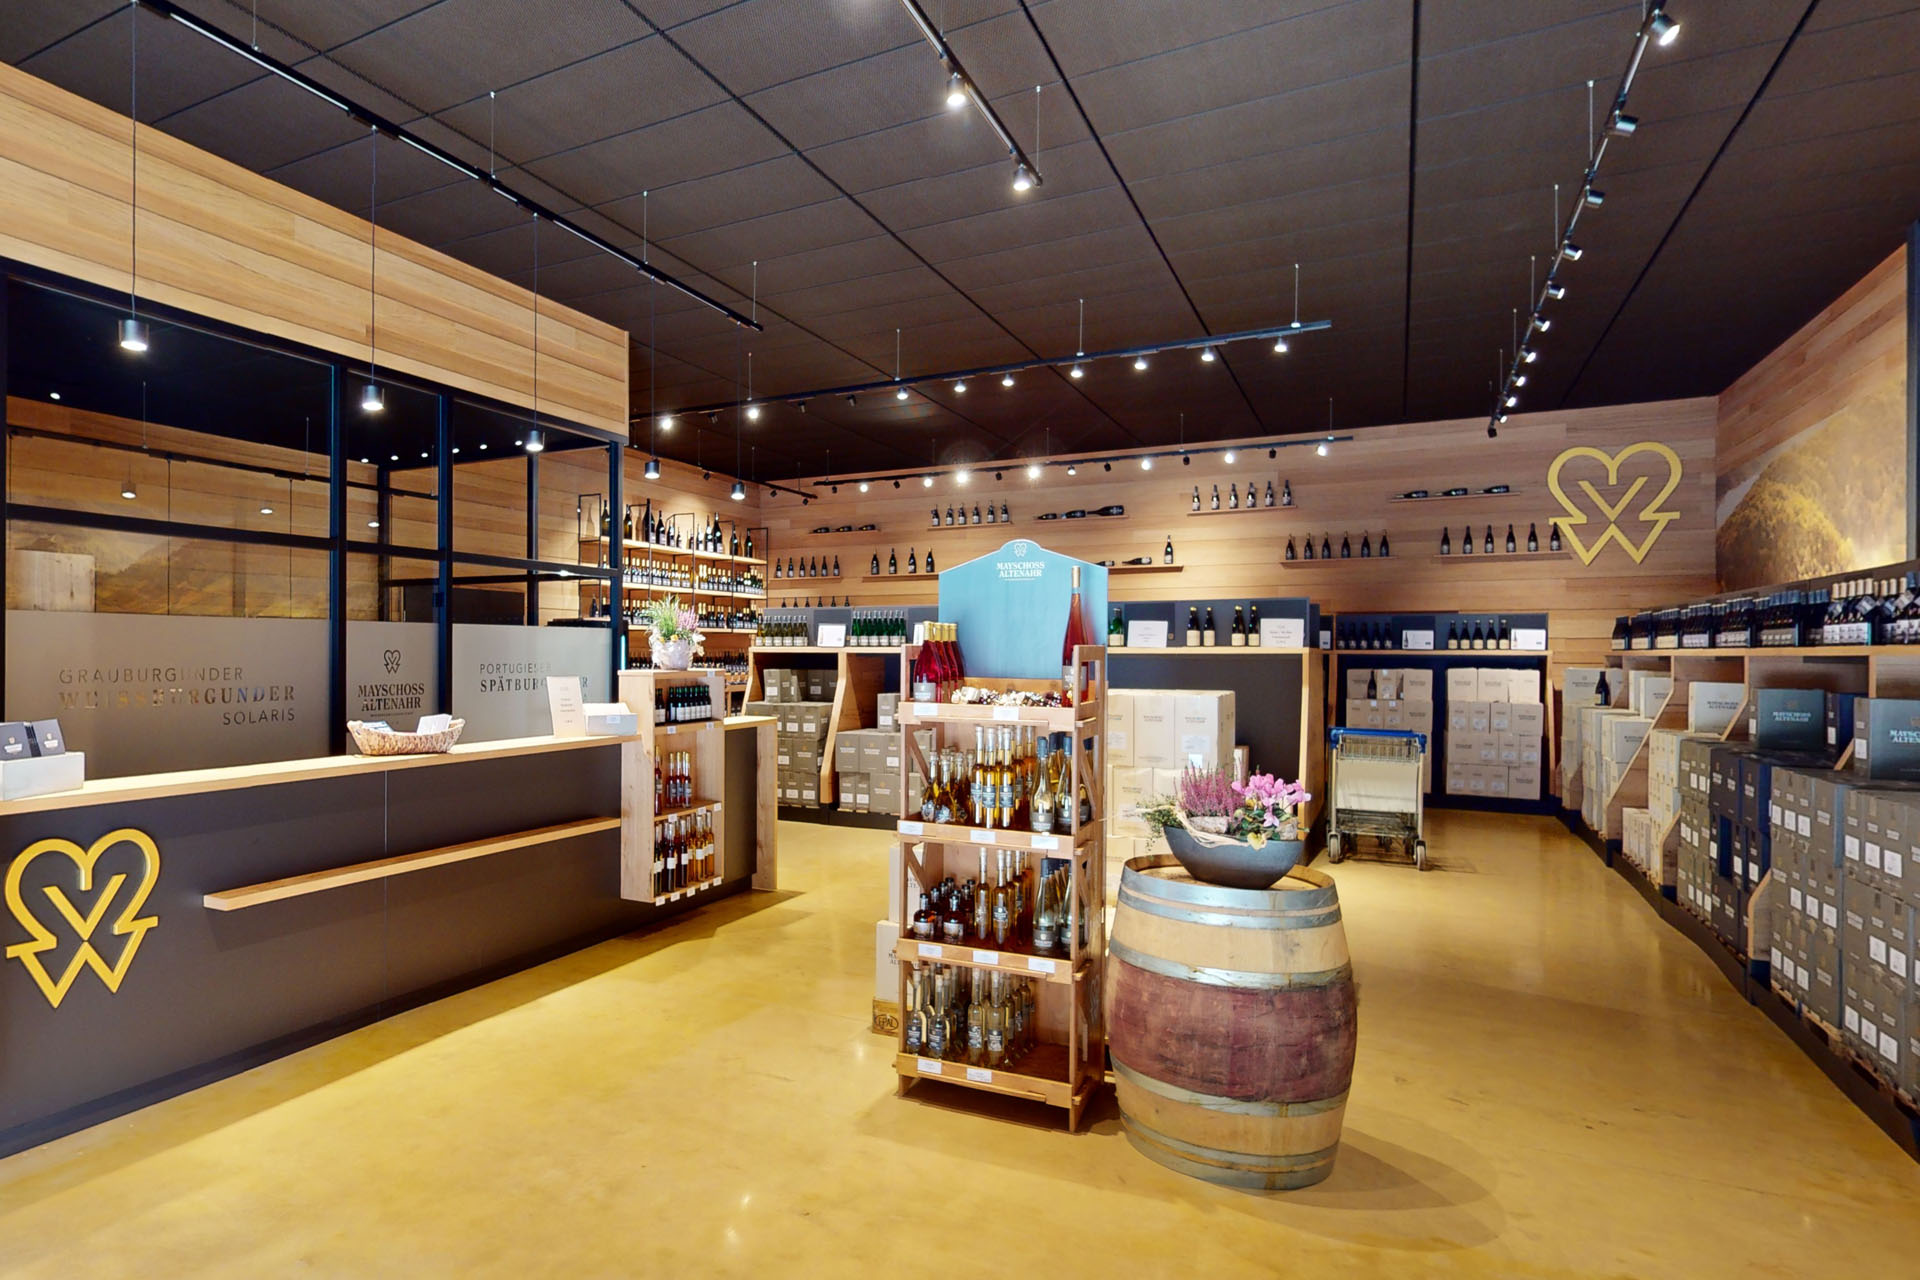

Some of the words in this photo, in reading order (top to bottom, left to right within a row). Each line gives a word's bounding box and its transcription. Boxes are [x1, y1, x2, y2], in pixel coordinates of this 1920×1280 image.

[997, 561, 1045, 570] MAYSCHOSS
[1000, 569, 1042, 578] ALTENAHR
[358, 683, 425, 698] MAYSCHOSS
[361, 696, 421, 712] ALTENAHR
[222, 707, 296, 726] SOLARIS
